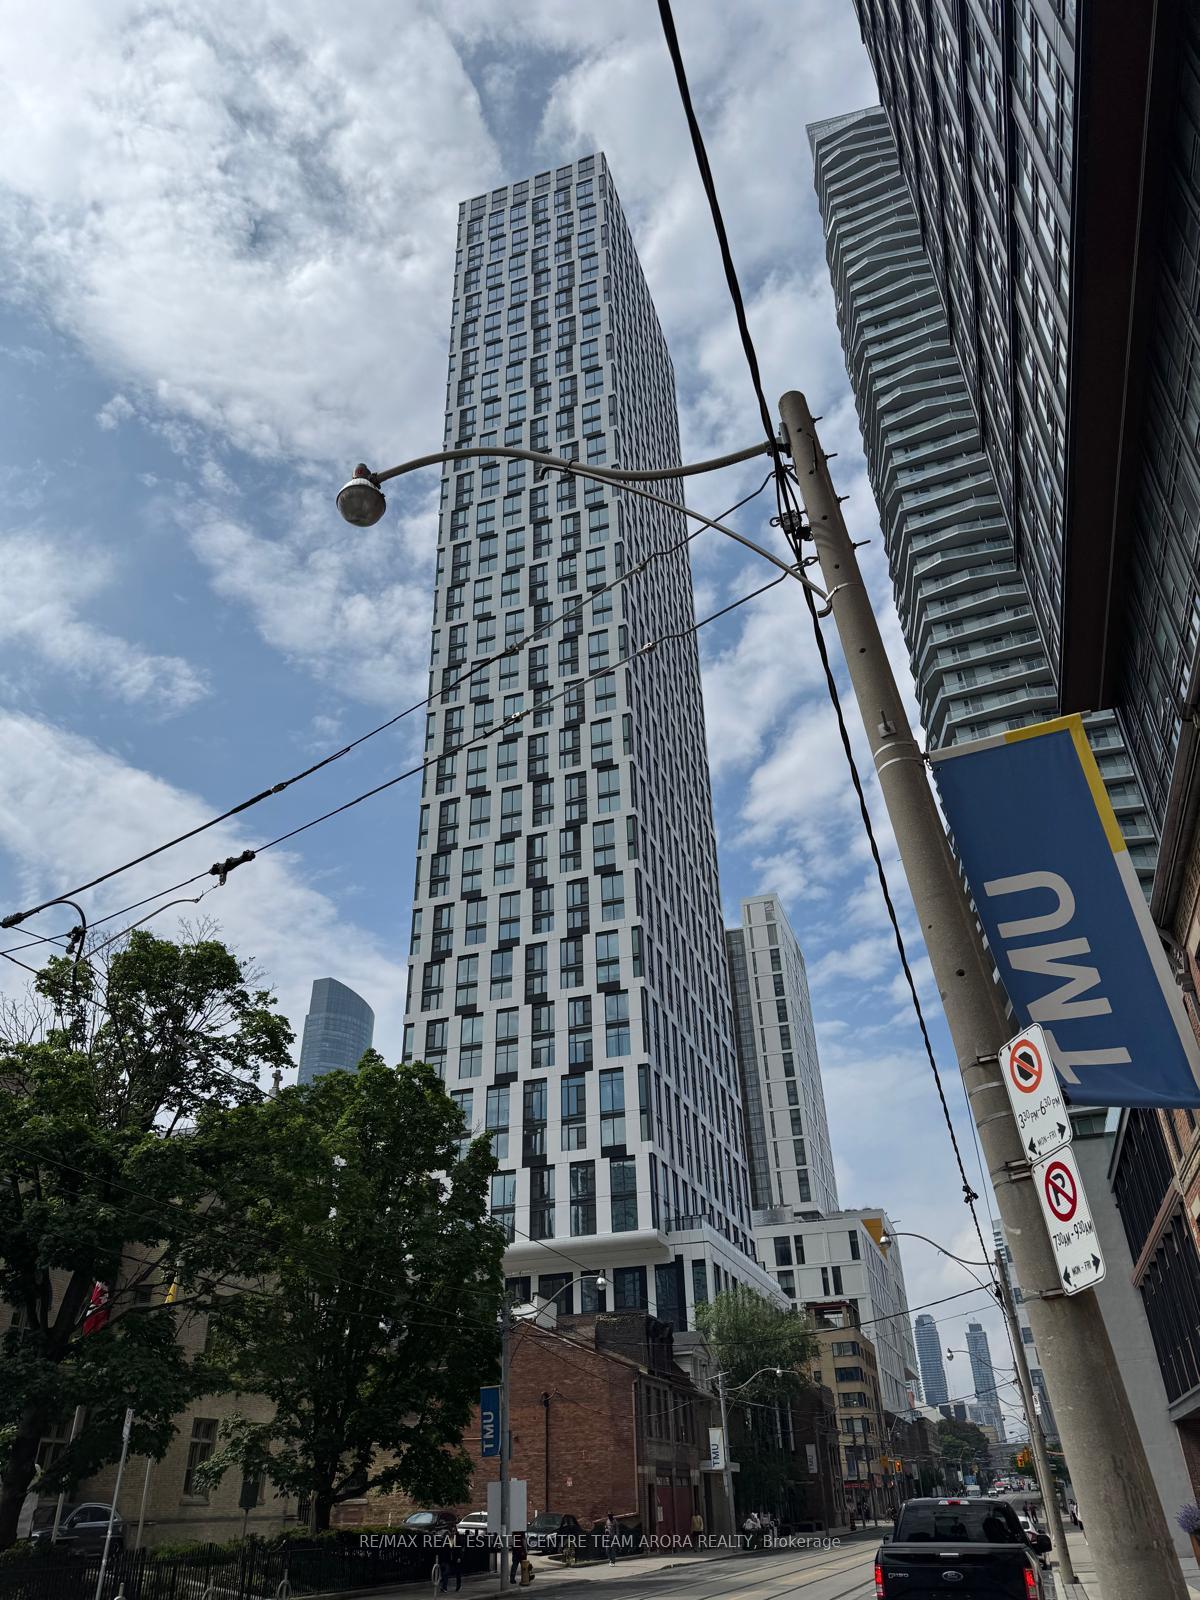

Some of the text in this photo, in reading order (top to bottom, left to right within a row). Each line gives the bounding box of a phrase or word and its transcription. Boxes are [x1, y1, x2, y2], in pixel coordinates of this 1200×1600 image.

[984, 870, 1132, 1084] TMU
[483, 1411, 494, 1452] TMU
[711, 1443, 720, 1467] TMU
